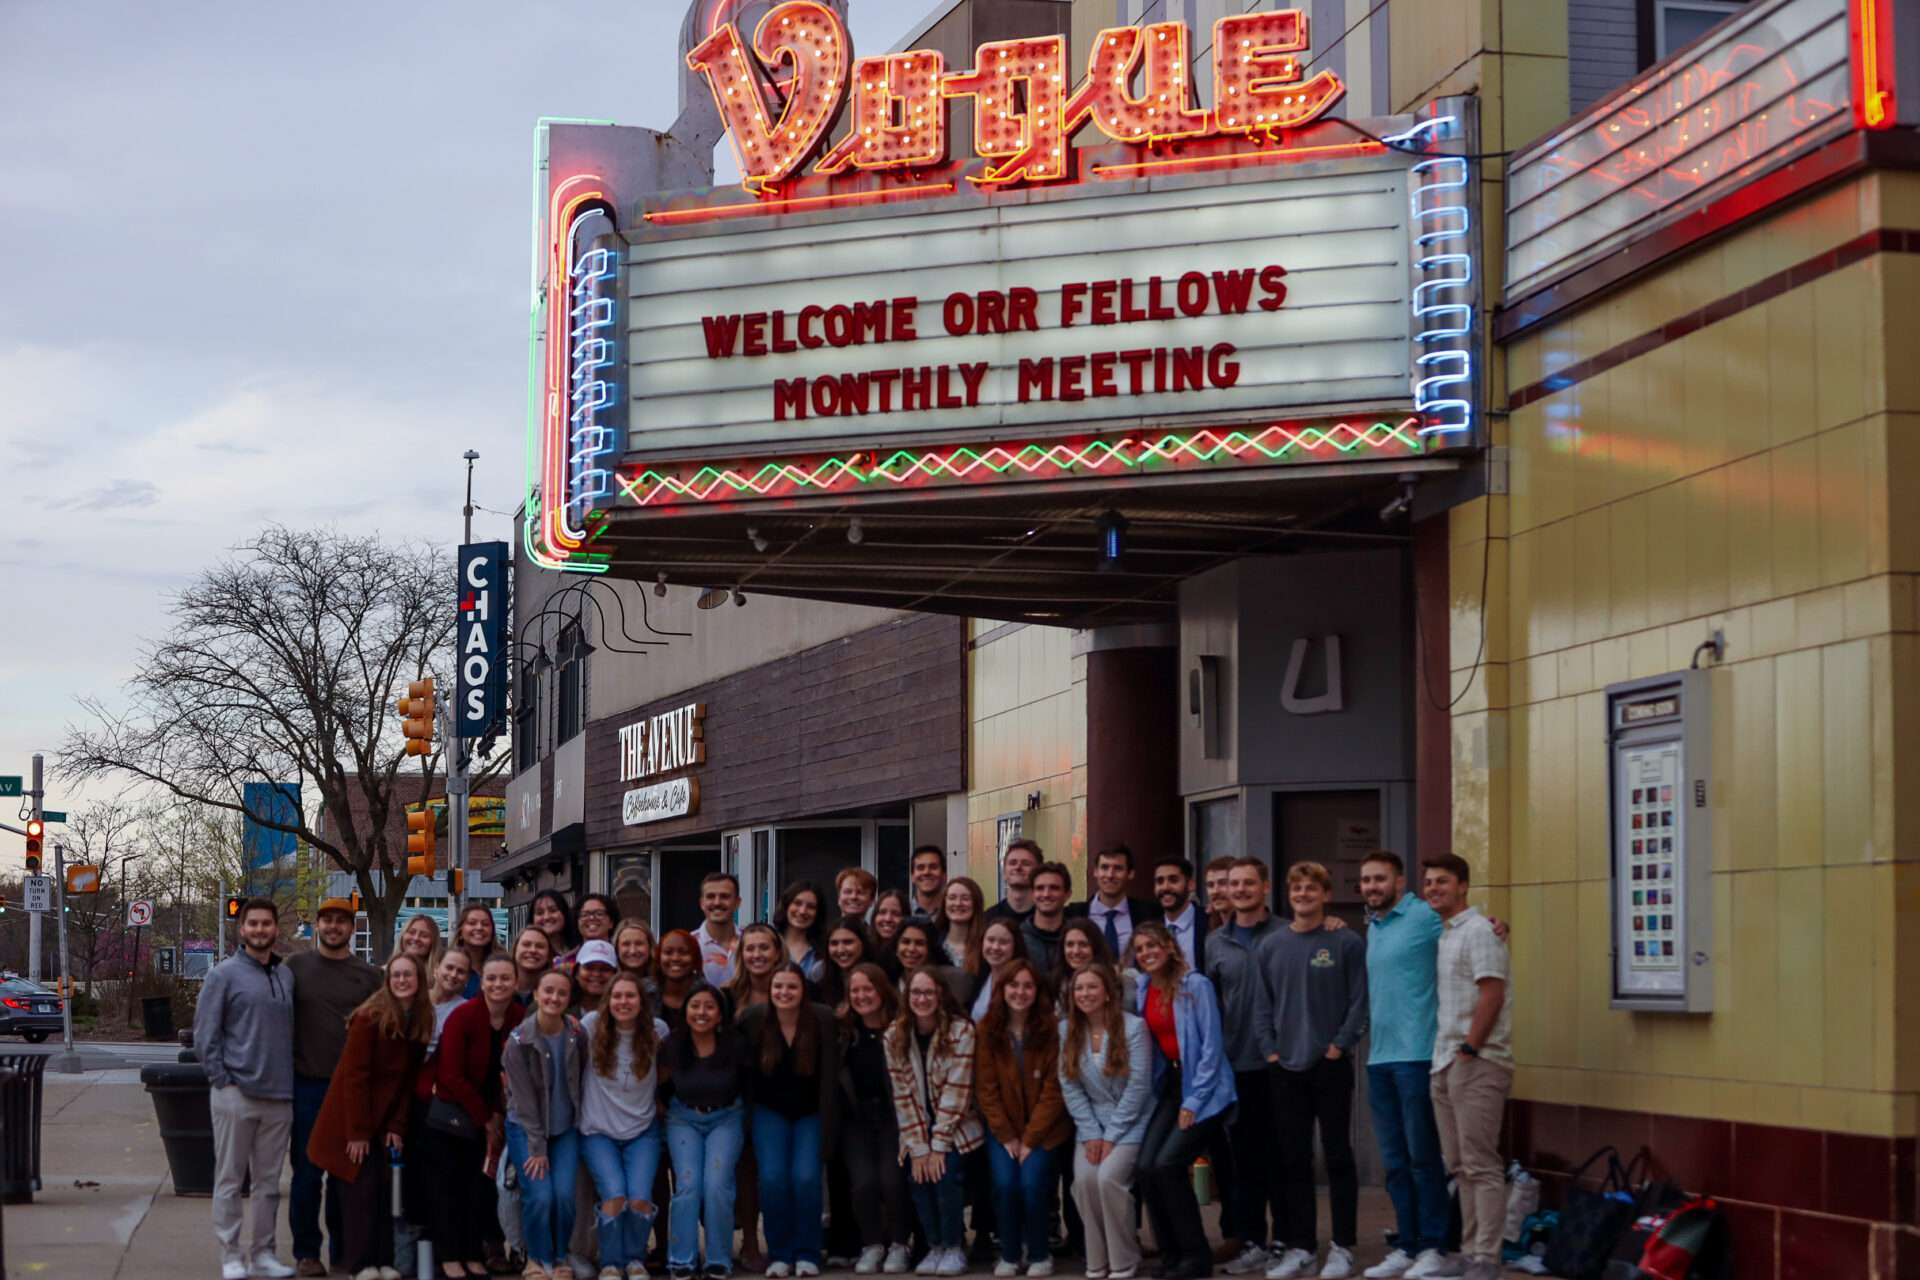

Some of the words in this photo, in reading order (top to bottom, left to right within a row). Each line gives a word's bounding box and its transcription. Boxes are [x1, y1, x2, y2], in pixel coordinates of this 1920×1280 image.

[702, 296, 917, 358] WELCOME
[942, 286, 1040, 336] ORR
[1061, 265, 1288, 328] FELLOWS
[773, 361, 989, 421] MONTHLY
[1017, 343, 1240, 403] MEETING
[460, 556, 489, 721] CHAOS
[619, 720, 646, 782] THE
[646, 703, 696, 775] AVENUE
[30, 879, 43, 887] NO
